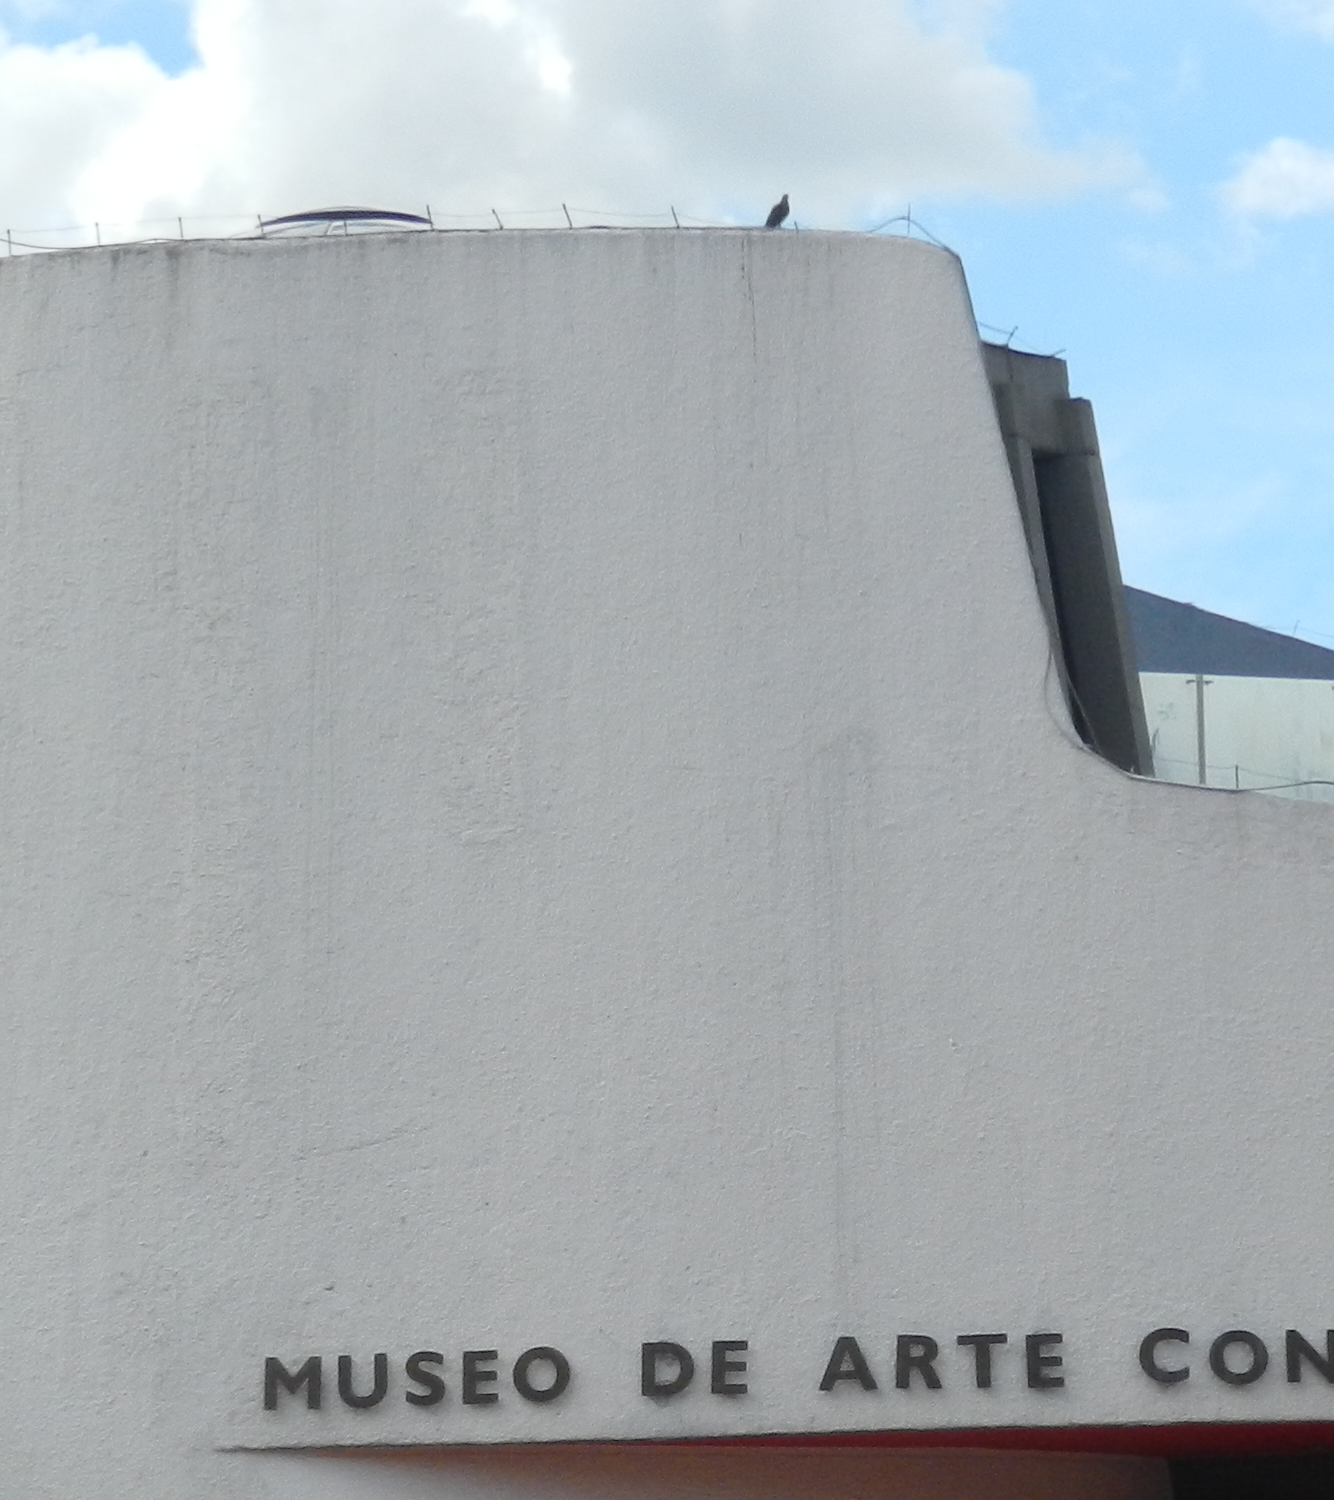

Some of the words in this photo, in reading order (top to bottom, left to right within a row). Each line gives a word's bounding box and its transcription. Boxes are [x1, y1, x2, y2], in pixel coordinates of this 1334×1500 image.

[262, 1346, 571, 1411] MUSEO
[640, 1340, 750, 1398] DE
[819, 1333, 1067, 1393] ARTE
